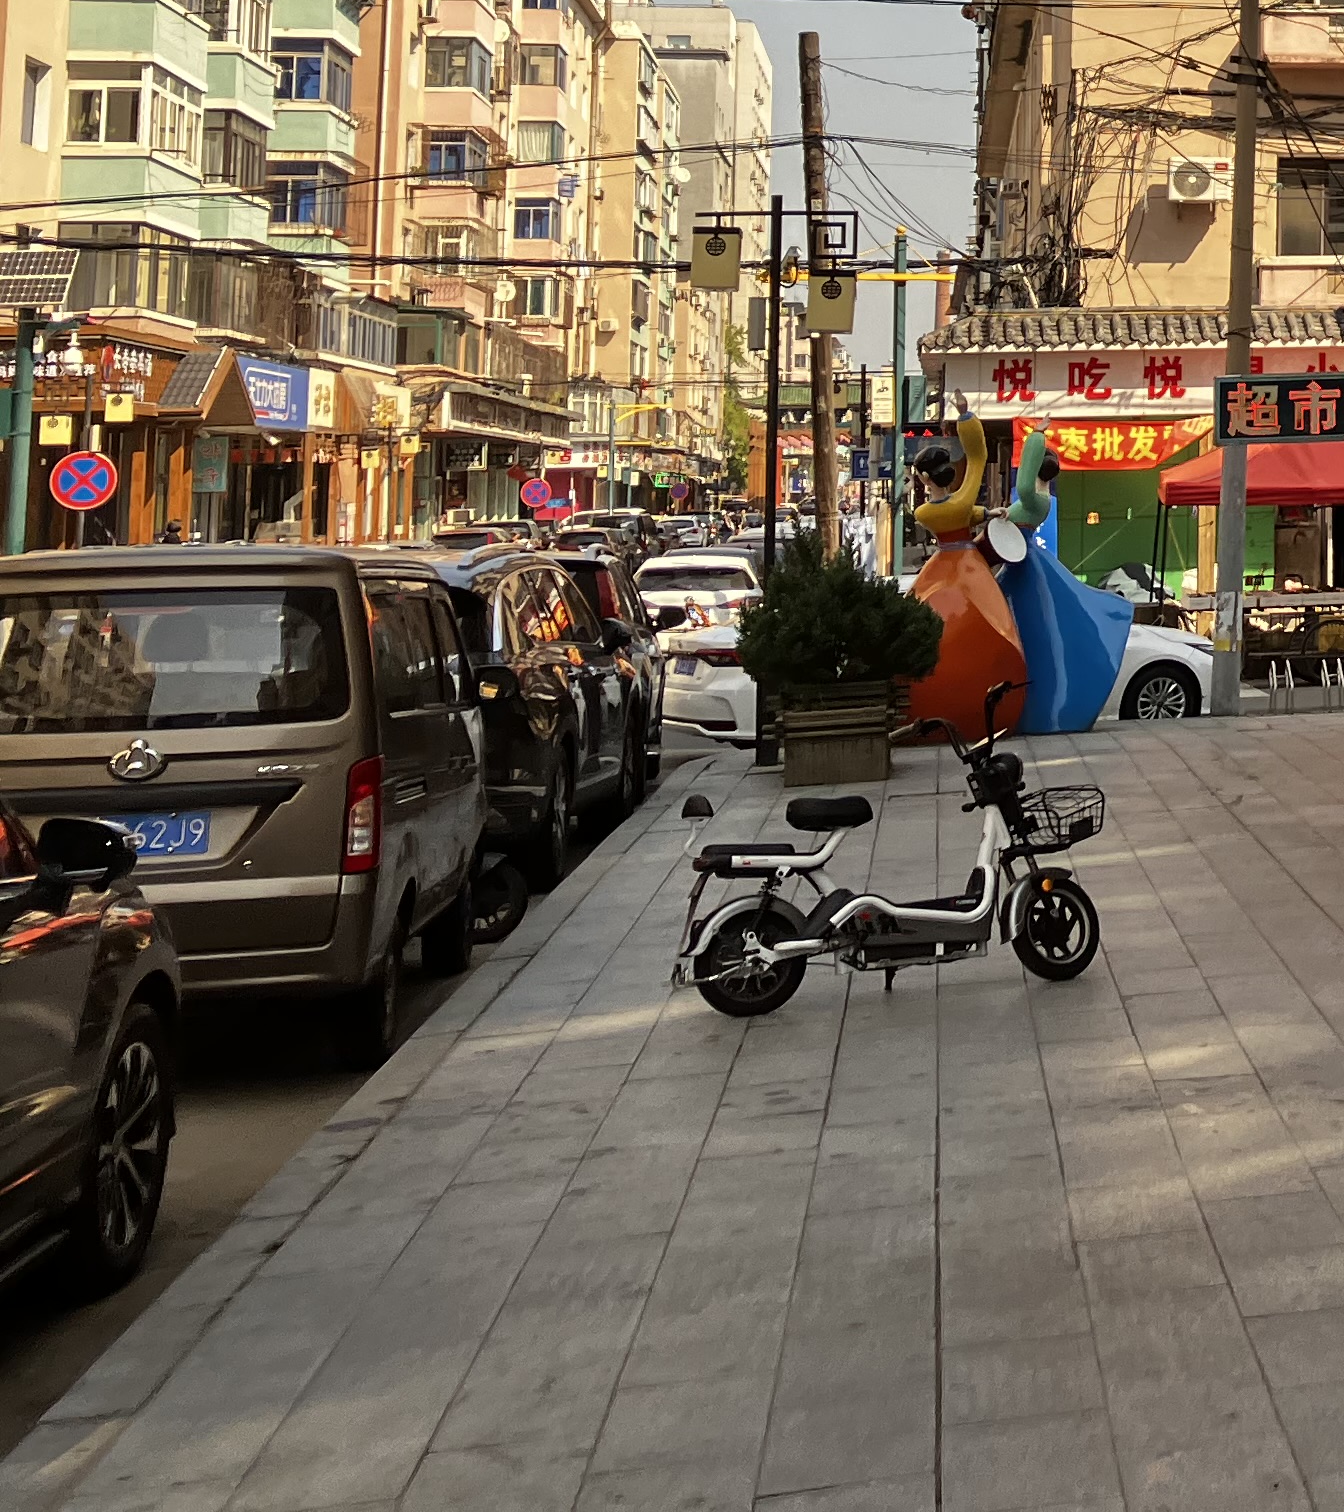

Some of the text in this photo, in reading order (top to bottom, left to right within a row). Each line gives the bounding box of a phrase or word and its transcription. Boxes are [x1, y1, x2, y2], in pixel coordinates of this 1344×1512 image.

[1227, 379, 1342, 437] 超市
[1022, 424, 1160, 463] 枣批发
